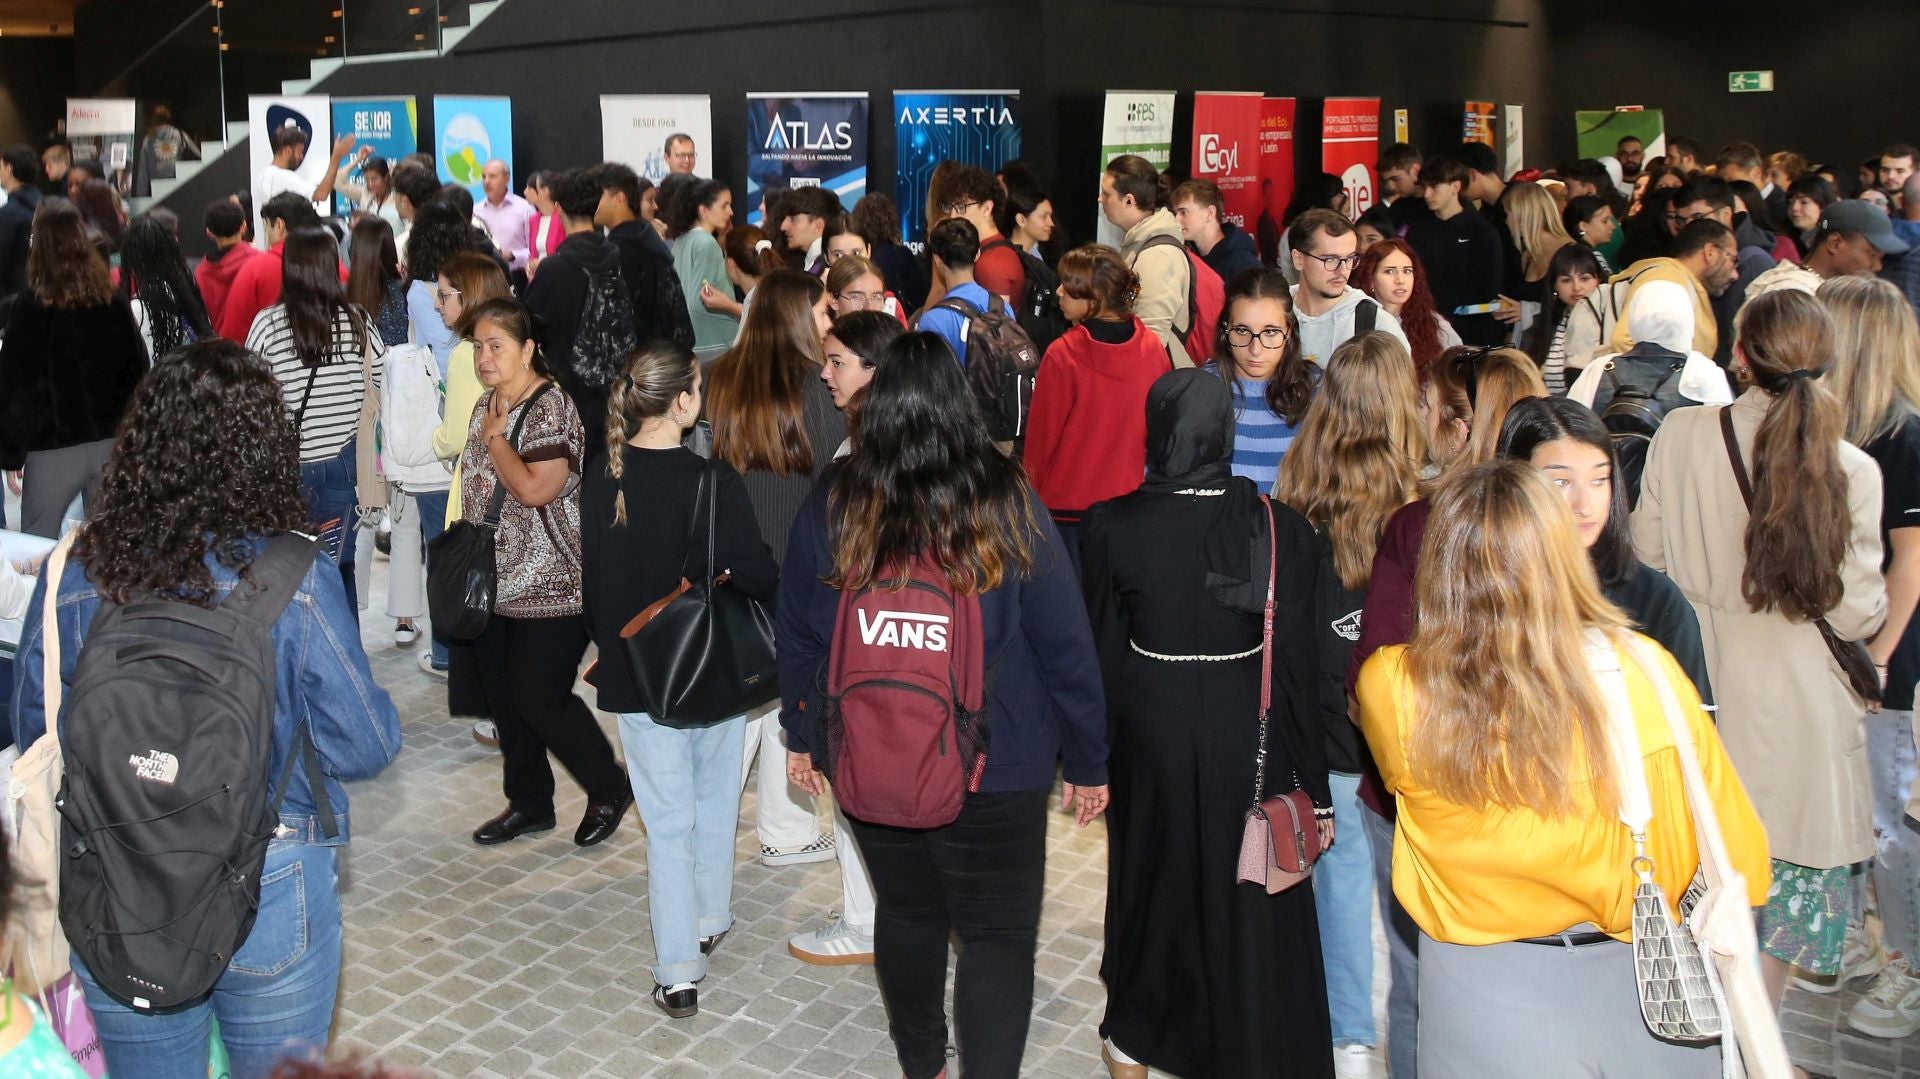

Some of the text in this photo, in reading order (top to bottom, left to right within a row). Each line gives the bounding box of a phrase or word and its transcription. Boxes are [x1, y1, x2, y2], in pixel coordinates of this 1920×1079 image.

[355, 111, 391, 131] SENIOR
[633, 118, 655, 128] DESDE
[900, 106, 1014, 125] AXERTIA
[764, 112, 852, 150] ATLAS
[762, 153, 790, 161] SALTANDO
[858, 608, 949, 652] VANS
[129, 754, 168, 770] NORTH
[149, 750, 169, 761] THE
[136, 766, 162, 779] FACE
